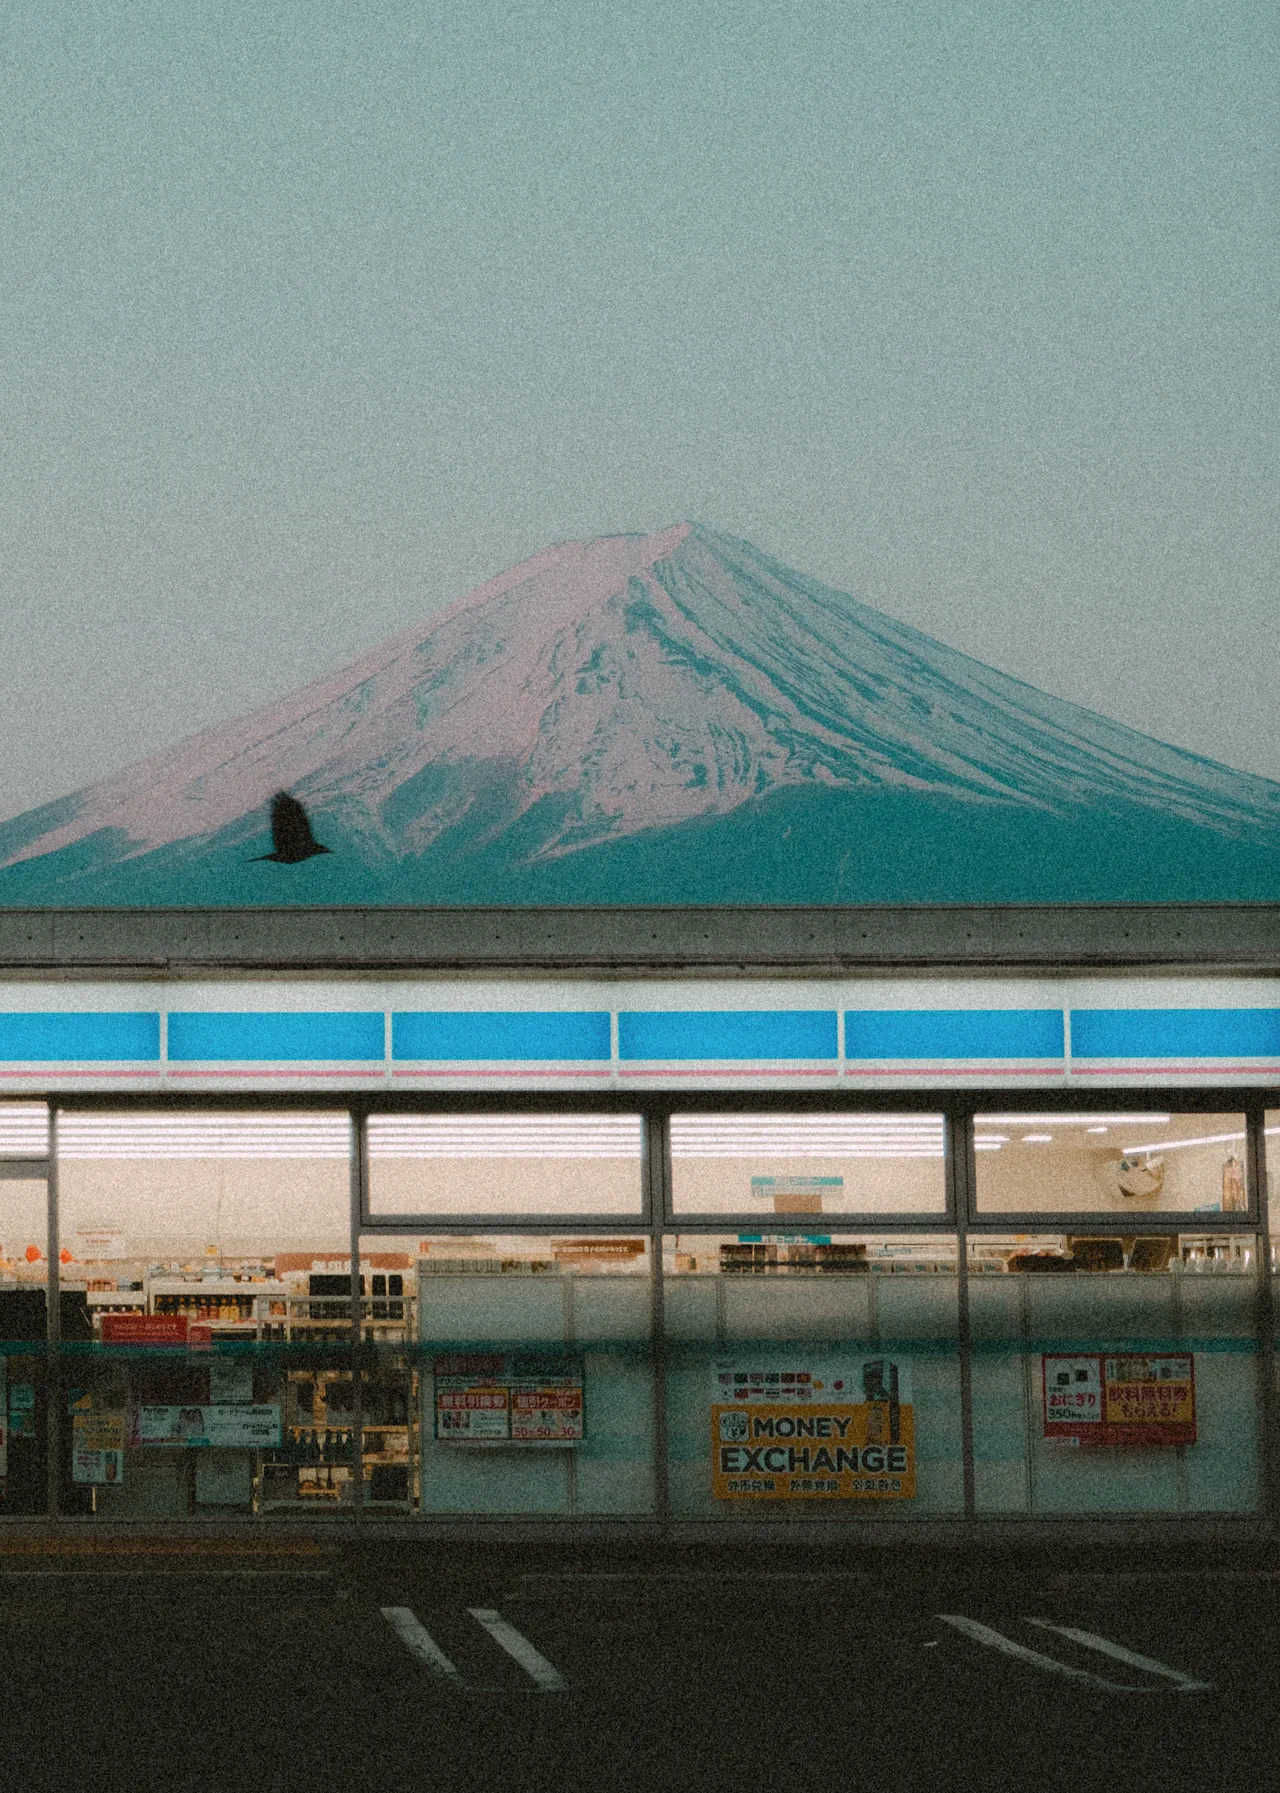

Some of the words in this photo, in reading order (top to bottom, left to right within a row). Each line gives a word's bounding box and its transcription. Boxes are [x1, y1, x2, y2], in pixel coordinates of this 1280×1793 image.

[1049, 1392, 1096, 1407] おにぎり
[753, 1416, 852, 1438] MONEY
[721, 1446, 908, 1473] EXCHANGE
